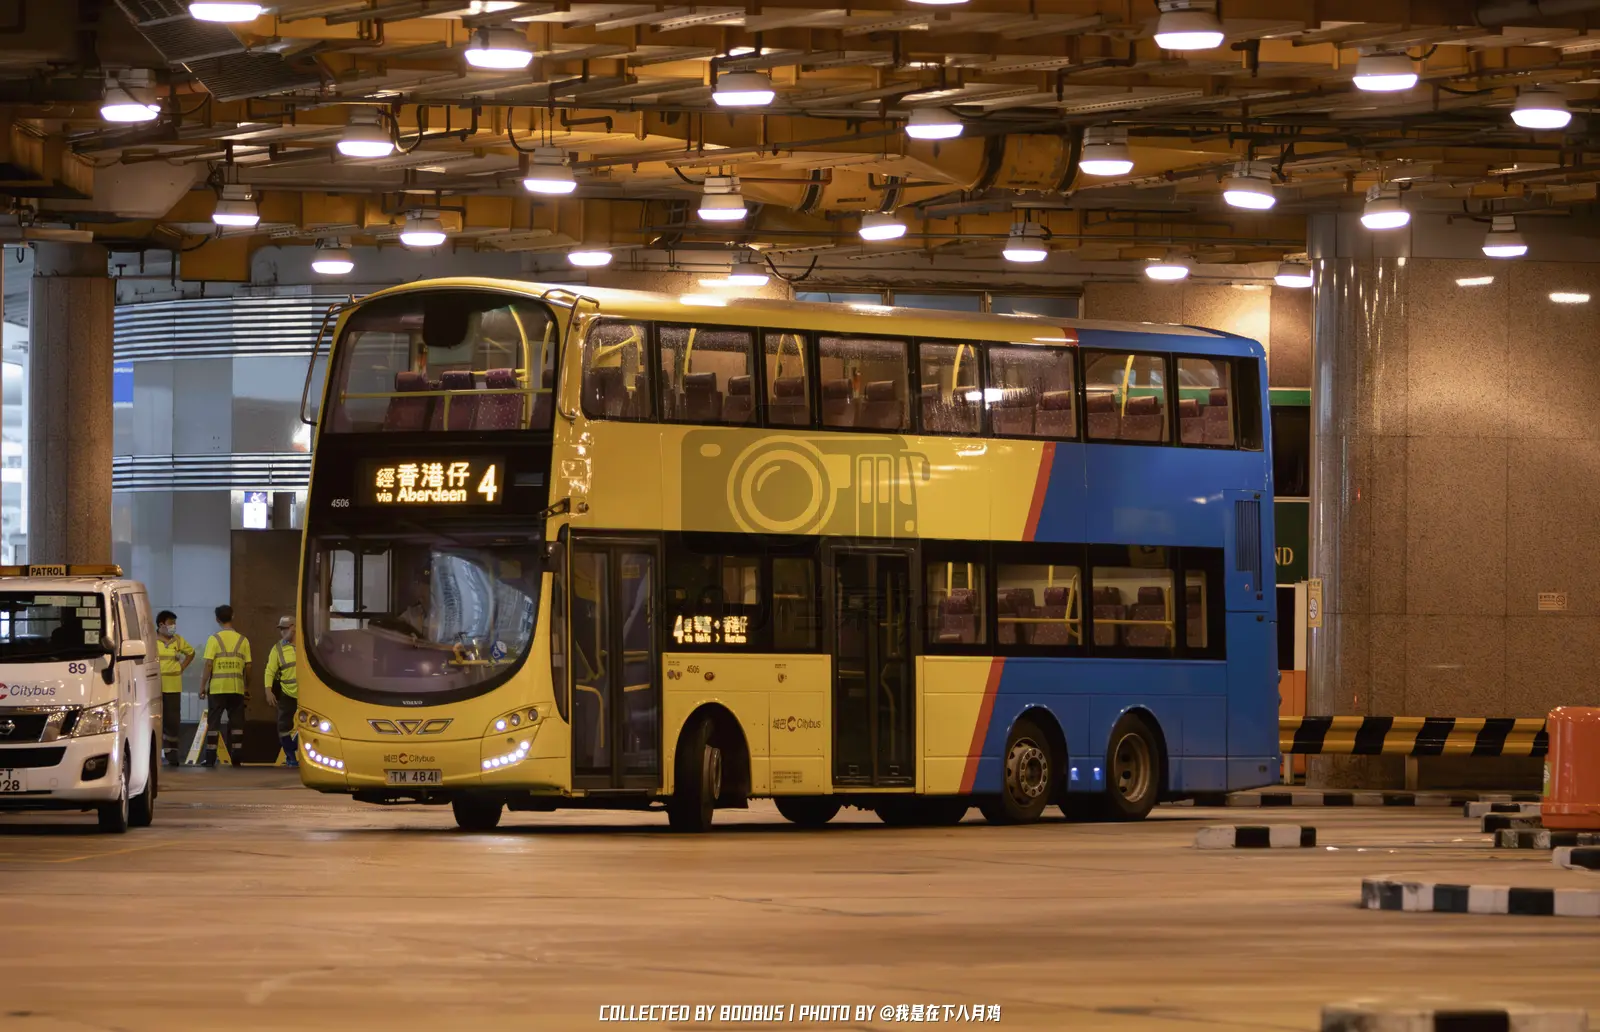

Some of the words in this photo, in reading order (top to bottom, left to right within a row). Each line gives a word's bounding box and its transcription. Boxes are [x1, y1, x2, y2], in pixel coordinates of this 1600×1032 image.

[376, 462, 470, 488] 經香港仔
[477, 464, 498, 503] 4
[376, 490, 393, 503] via
[397, 488, 467, 502] Aberdeen
[331, 499, 350, 509] 4506
[30, 566, 65, 577] PATROL
[673, 615, 684, 643] 4
[68, 662, 87, 674] 89
[9, 685, 56, 697] Citybus
[797, 718, 821, 731] Citybus
[409, 754, 435, 763] Citybus
[393, 772, 407, 782] TM
[412, 772, 437, 782] 4841
[0, 780, 20, 791] 28
